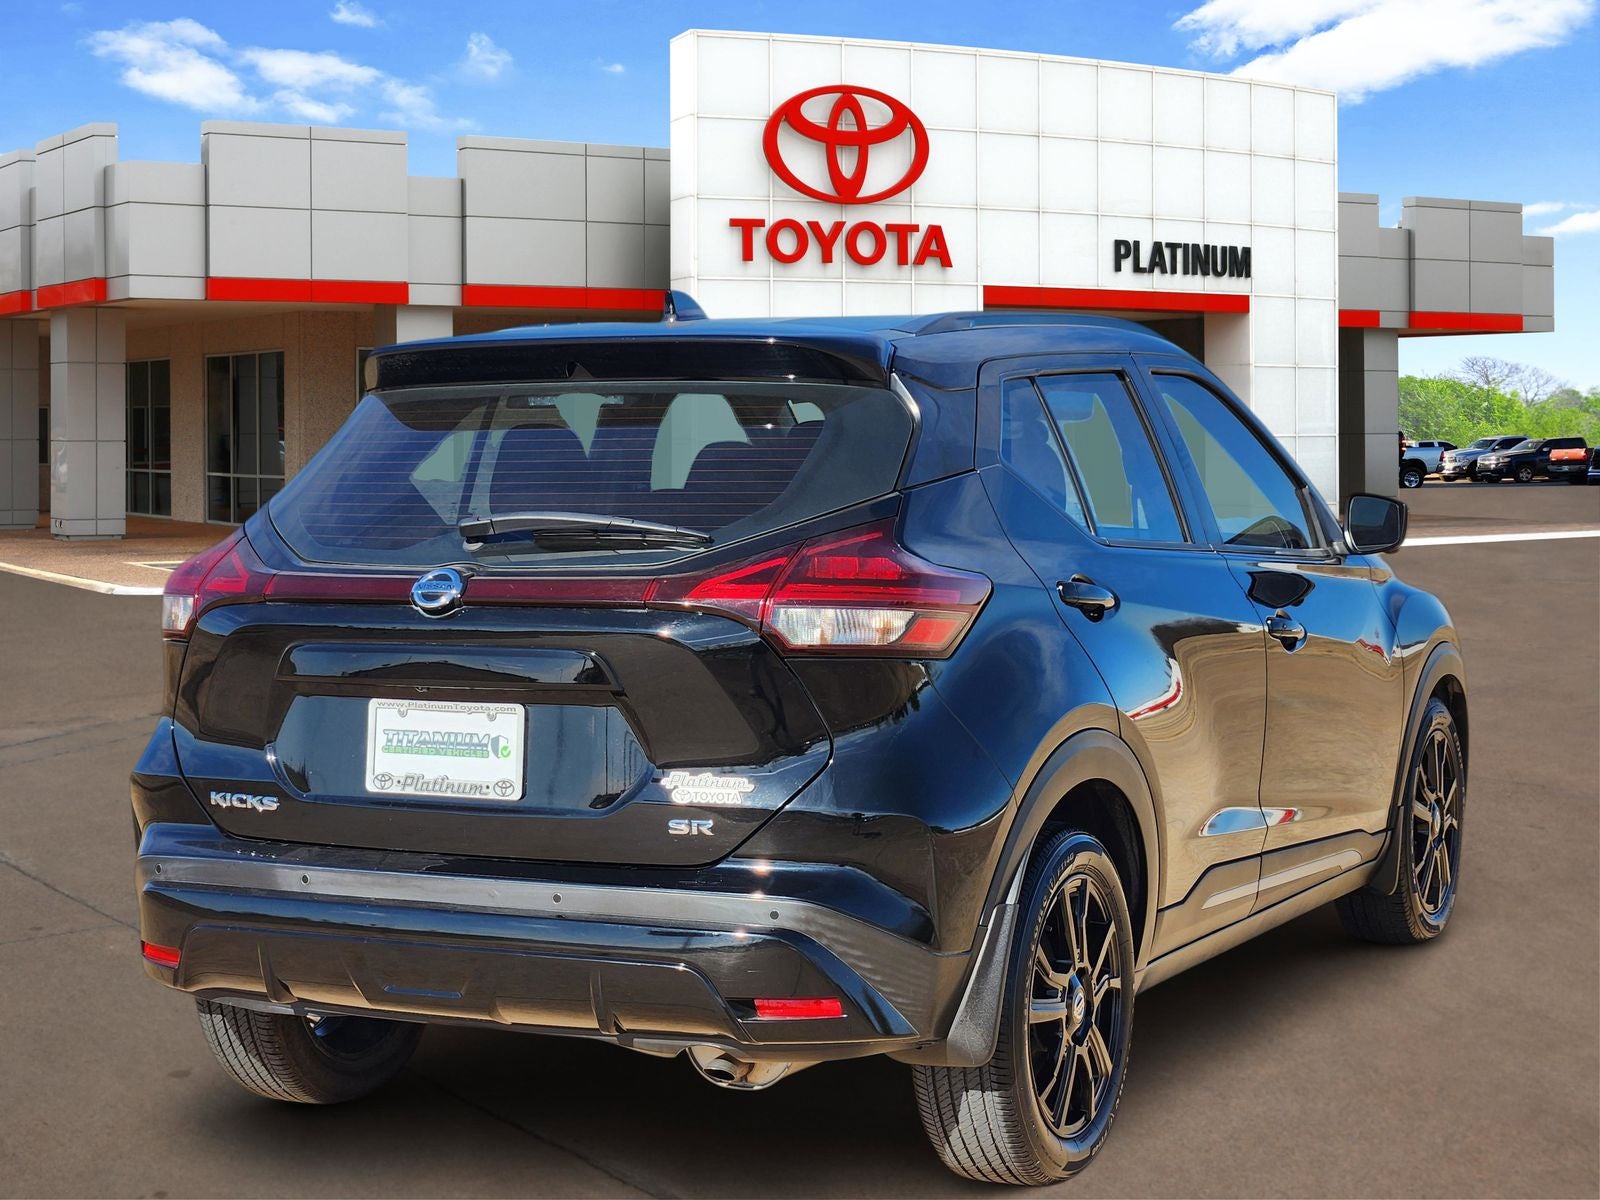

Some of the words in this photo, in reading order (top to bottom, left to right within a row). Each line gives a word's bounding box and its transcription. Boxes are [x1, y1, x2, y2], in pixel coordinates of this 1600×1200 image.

[729, 218, 953, 268] TOYOTA
[1114, 239, 1252, 278] PLATINUM
[417, 583, 455, 591] NISSAN
[377, 701, 517, 713] www.PlatinumToyota.com
[383, 729, 491, 750] TITANIUM
[439, 748, 490, 758] VEHICLES
[400, 773, 490, 796] Platinum
[662, 772, 754, 791] Platinum
[210, 791, 279, 812] KICKS
[692, 791, 741, 802] TOYOTA
[667, 819, 715, 836] SR
